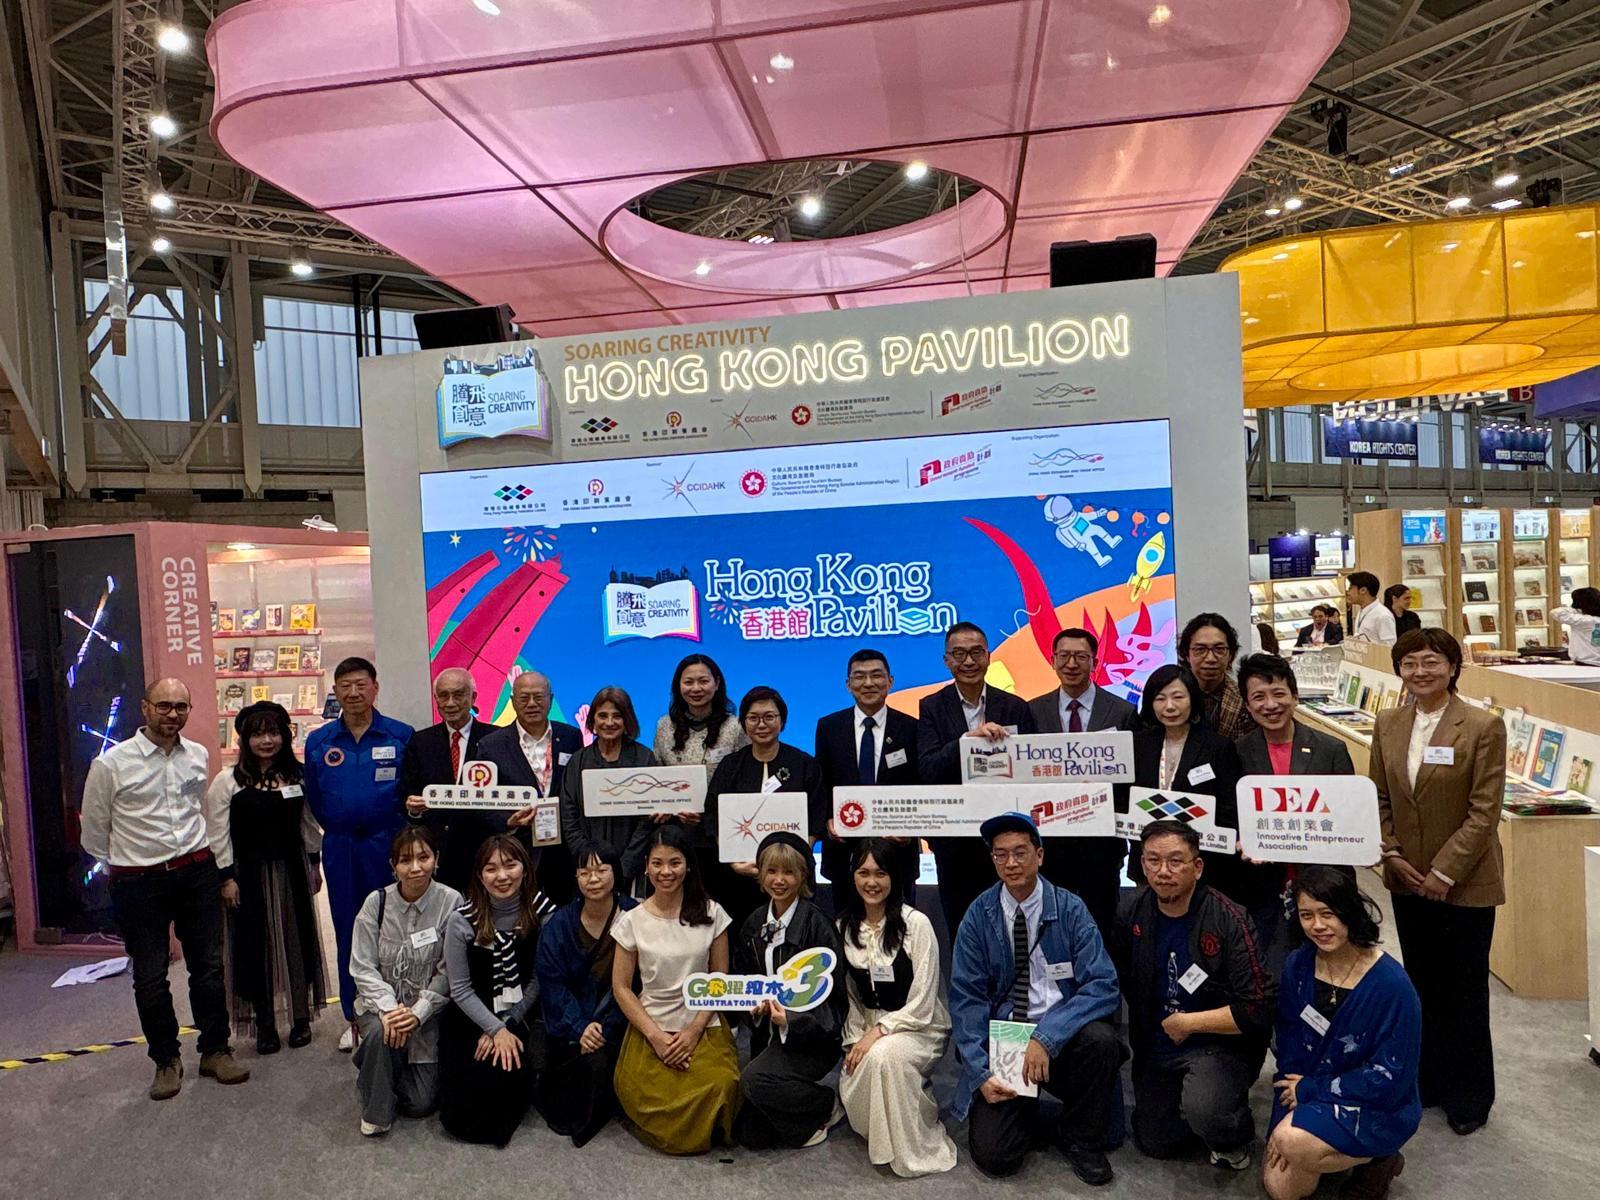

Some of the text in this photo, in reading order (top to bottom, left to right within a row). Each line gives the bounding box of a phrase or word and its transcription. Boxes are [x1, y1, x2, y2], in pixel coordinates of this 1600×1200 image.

[564, 325, 771, 361] SOARING CREATIVITY
[565, 314, 1129, 403] HONG KONG PAVILION
[488, 390, 525, 402] SOARING
[488, 400, 536, 414] CREATIVITY
[1349, 441, 1417, 456] KOREA RIGHTS CENTER
[687, 481, 726, 492] CCIDAHK
[704, 552, 930, 603] Hong Kong
[161, 556, 183, 652] CORNER
[648, 598, 681, 609] SOARING
[180, 556, 202, 666] CREATIVE
[648, 607, 689, 618] CREATIVITY
[741, 607, 811, 639] 香港館
[1016, 742, 1115, 762] Hong Kong
[1032, 765, 1062, 777] 香港館
[756, 822, 800, 832] CCIDAHK
[1256, 818, 1334, 832] 創意創業會
[1257, 832, 1365, 844] Innovative Entrepreneur
[1258, 842, 1308, 852] Association
[689, 999, 758, 1007] ILLUSTRATORS
